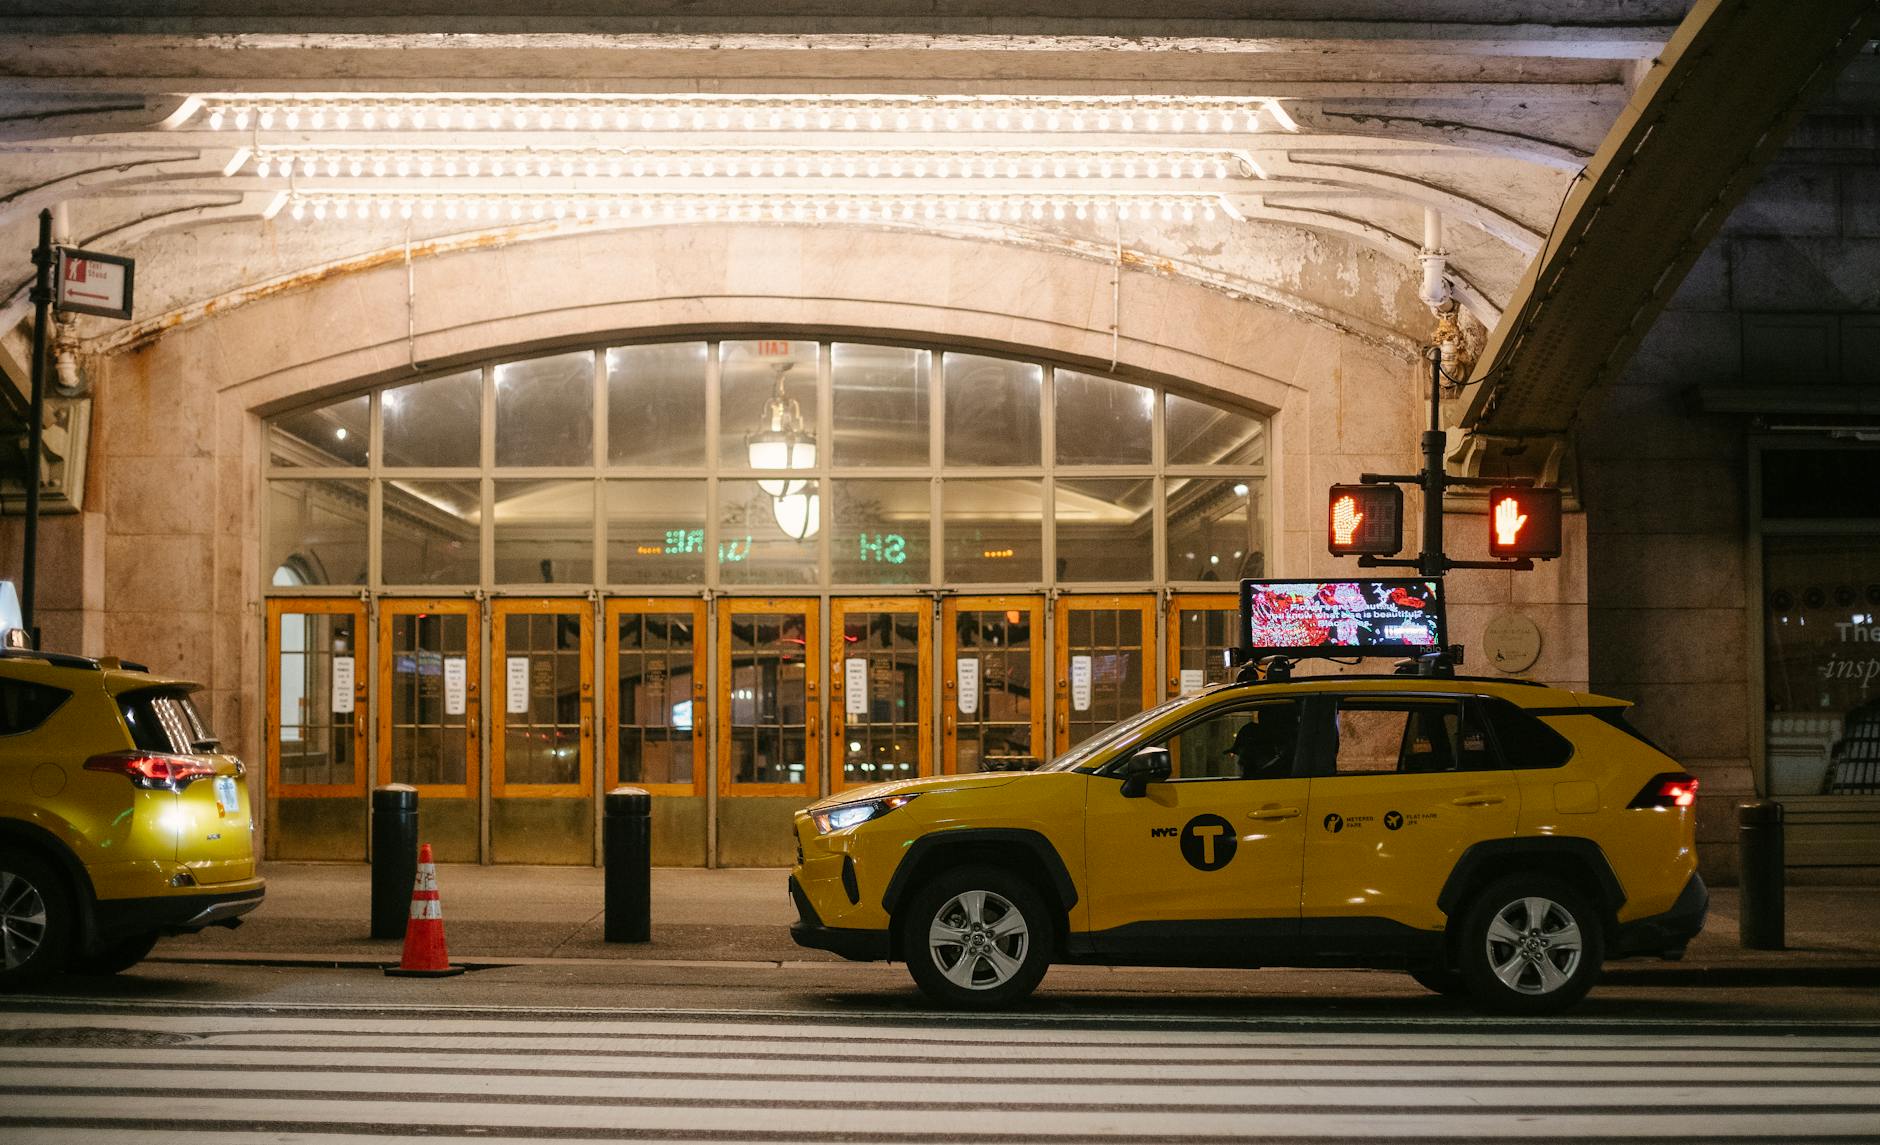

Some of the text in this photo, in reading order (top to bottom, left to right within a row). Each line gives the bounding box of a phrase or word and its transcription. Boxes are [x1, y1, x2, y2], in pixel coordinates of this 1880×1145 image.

[1363, 611, 1372, 619] is
[1835, 621, 1880, 643] The
[1151, 827, 1178, 838] NYC
[1192, 825, 1224, 864] T
